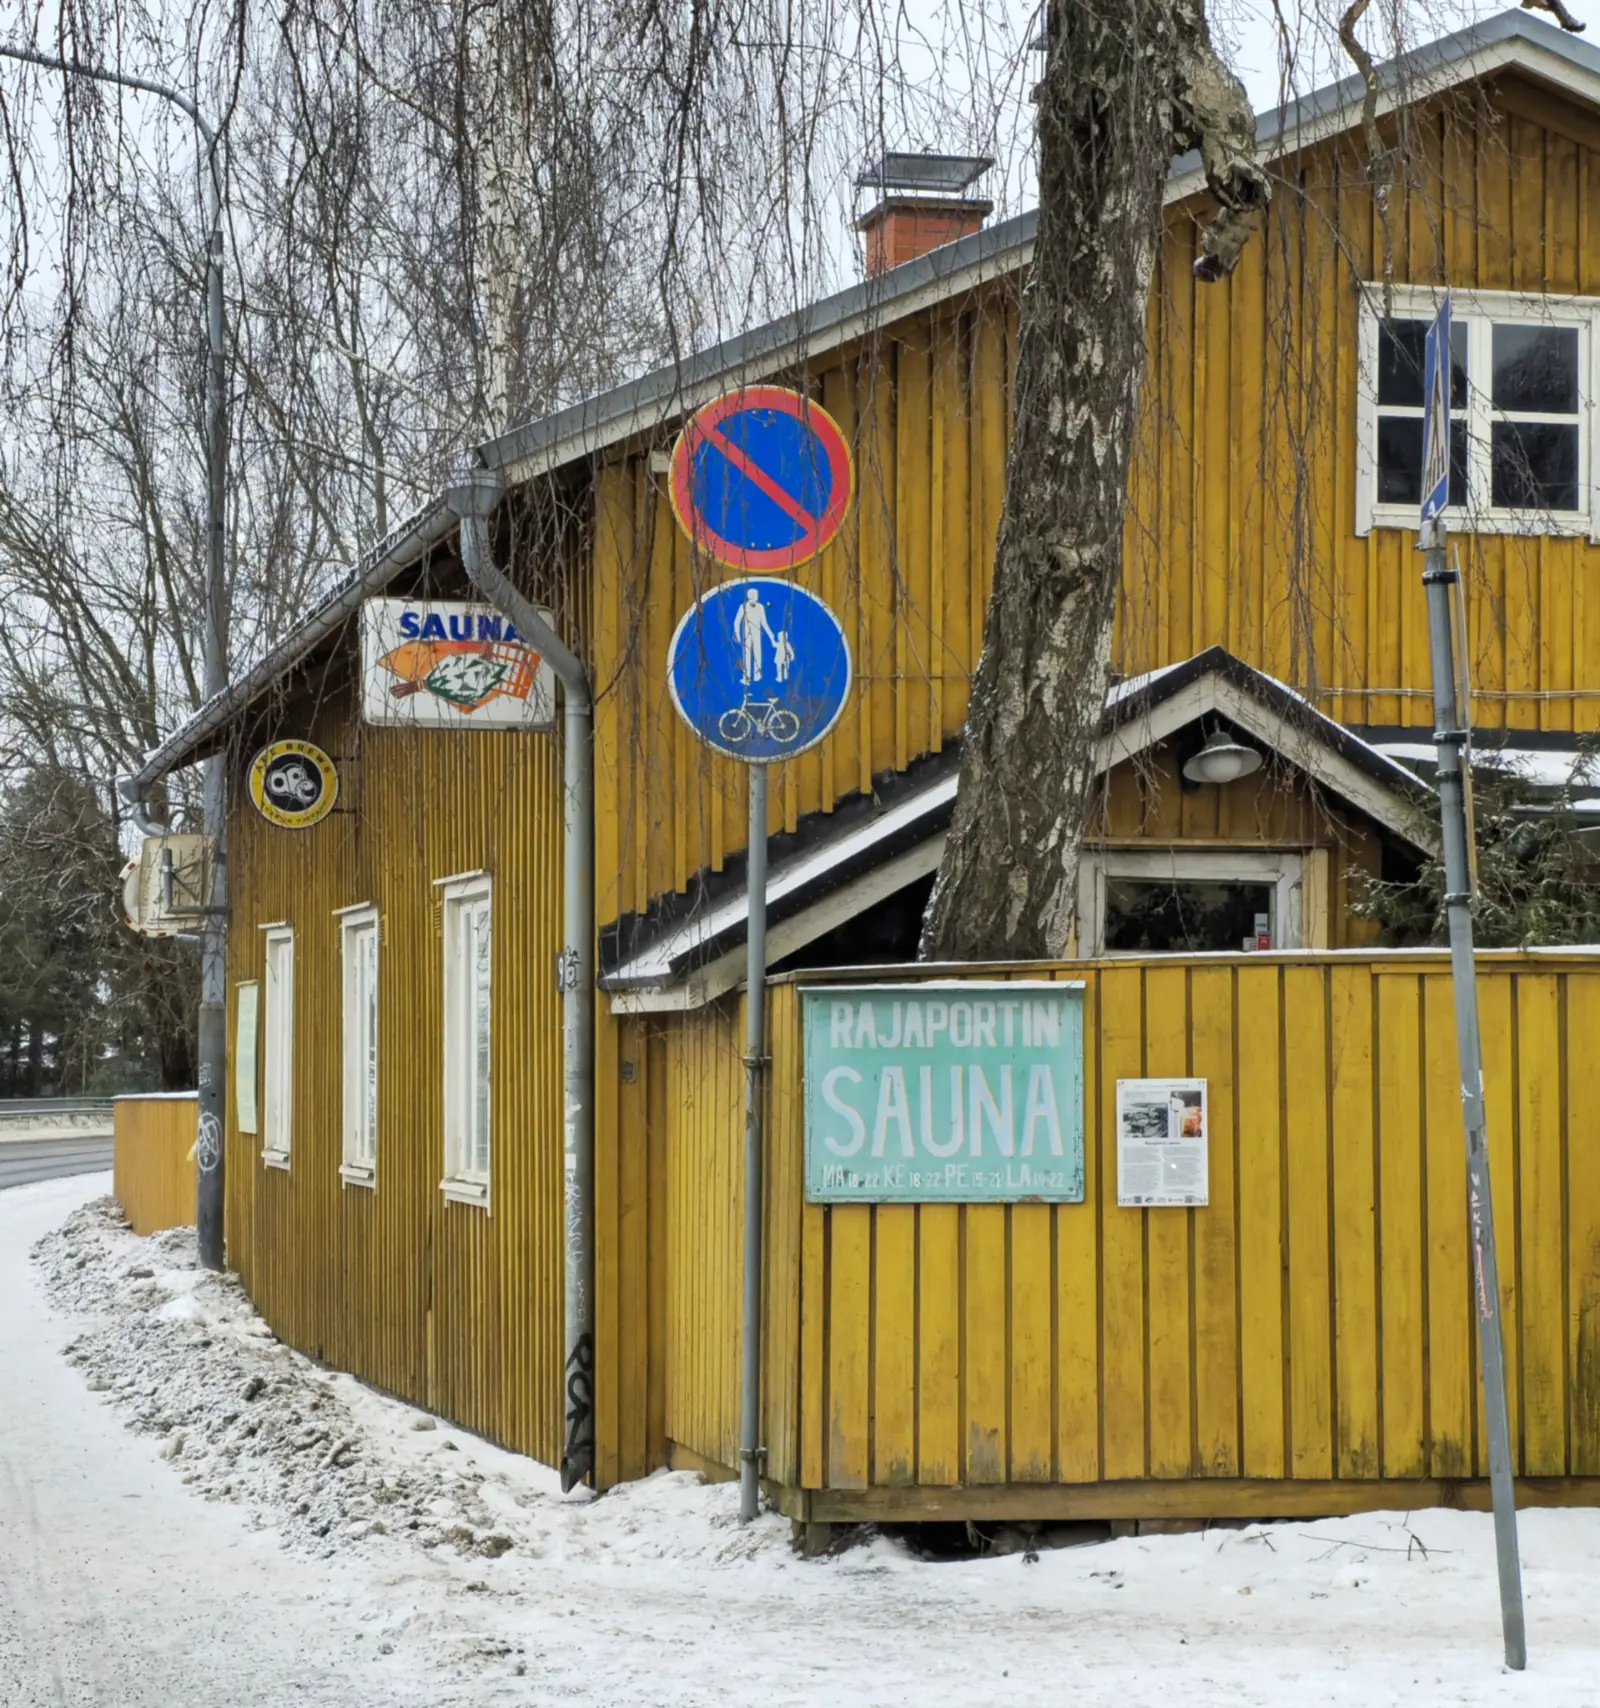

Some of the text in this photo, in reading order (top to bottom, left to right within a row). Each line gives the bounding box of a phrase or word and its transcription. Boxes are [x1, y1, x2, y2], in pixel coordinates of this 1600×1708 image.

[830, 1001, 1060, 1049] RAJAPORTIN
[821, 1064, 1064, 1158] SAUNA
[883, 1164, 906, 1188] KE
[945, 1164, 969, 1188] PE
[1006, 1164, 1031, 1188] LA
